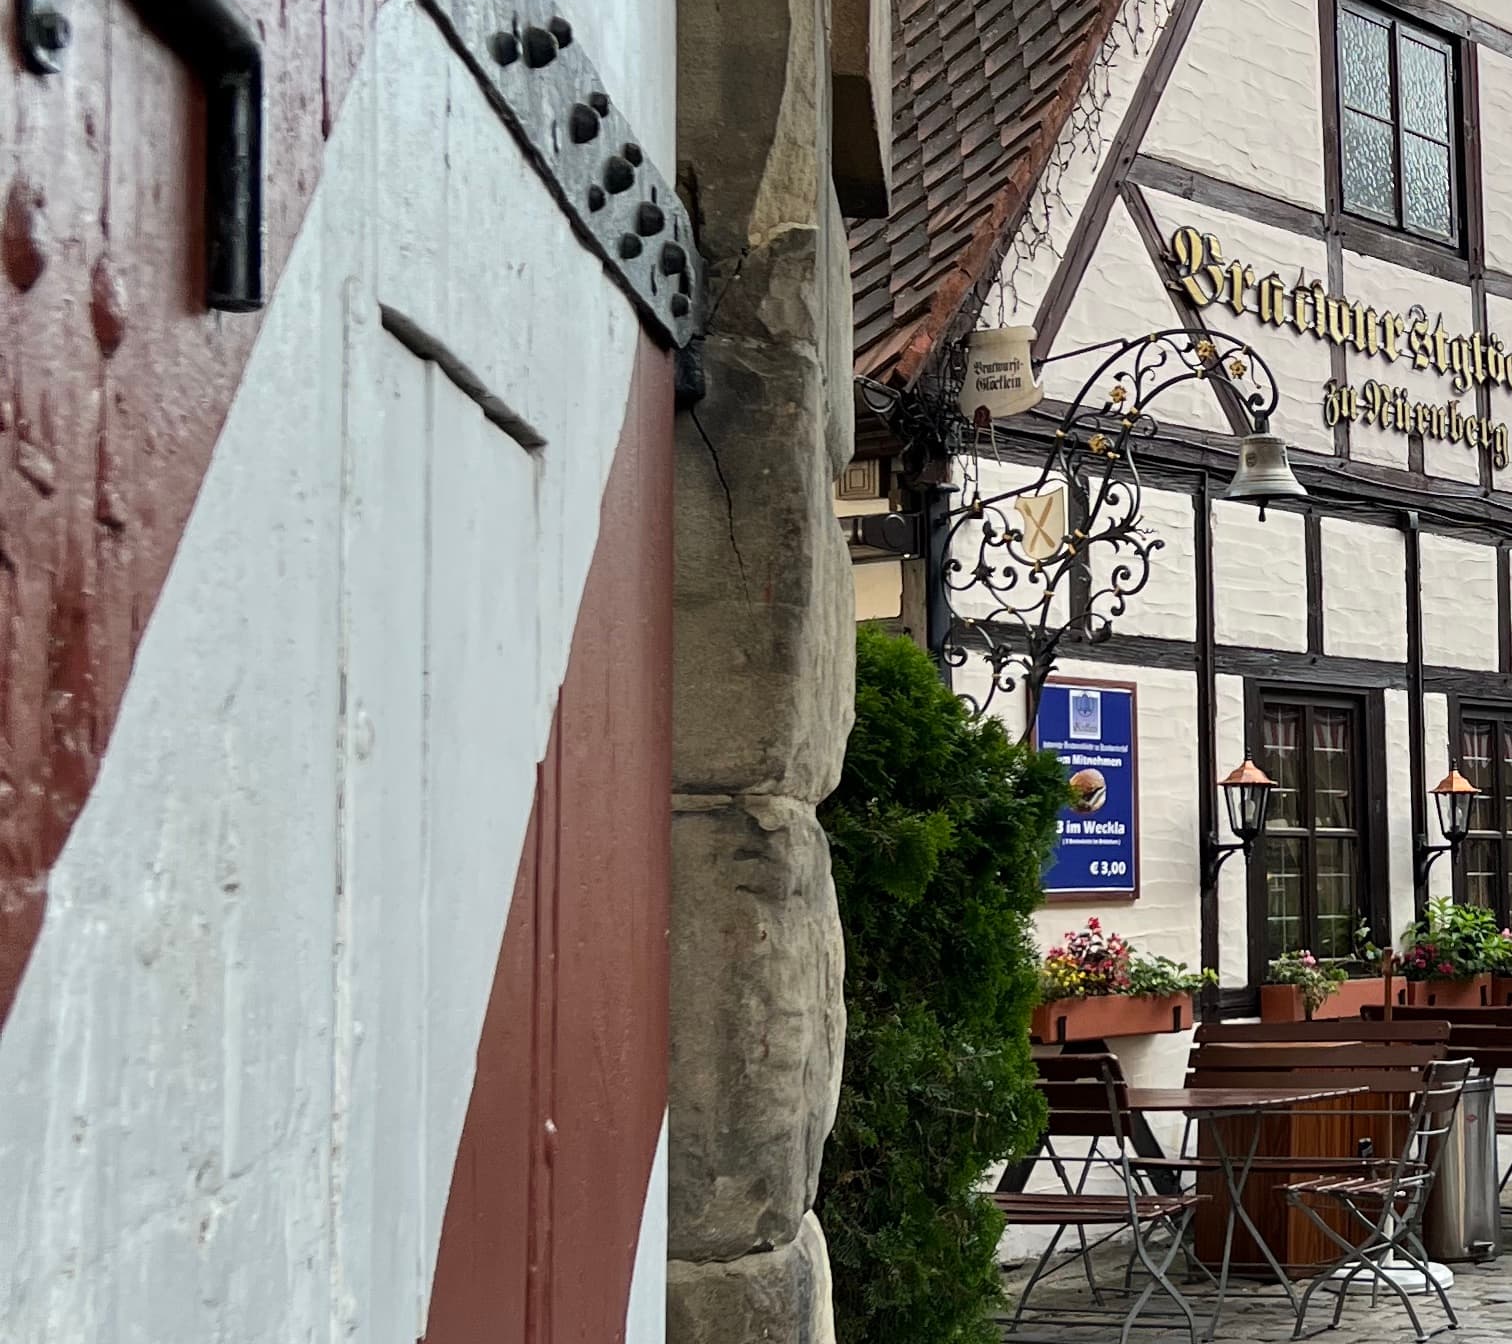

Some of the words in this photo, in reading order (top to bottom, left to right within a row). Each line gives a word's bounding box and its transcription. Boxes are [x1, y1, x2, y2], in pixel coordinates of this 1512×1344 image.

[1364, 378, 1509, 470] Nürnberg
[1065, 820, 1081, 834] im
[1083, 820, 1126, 835] Weckla
[1089, 861, 1099, 875] €
[1100, 860, 1127, 877] 3,00
